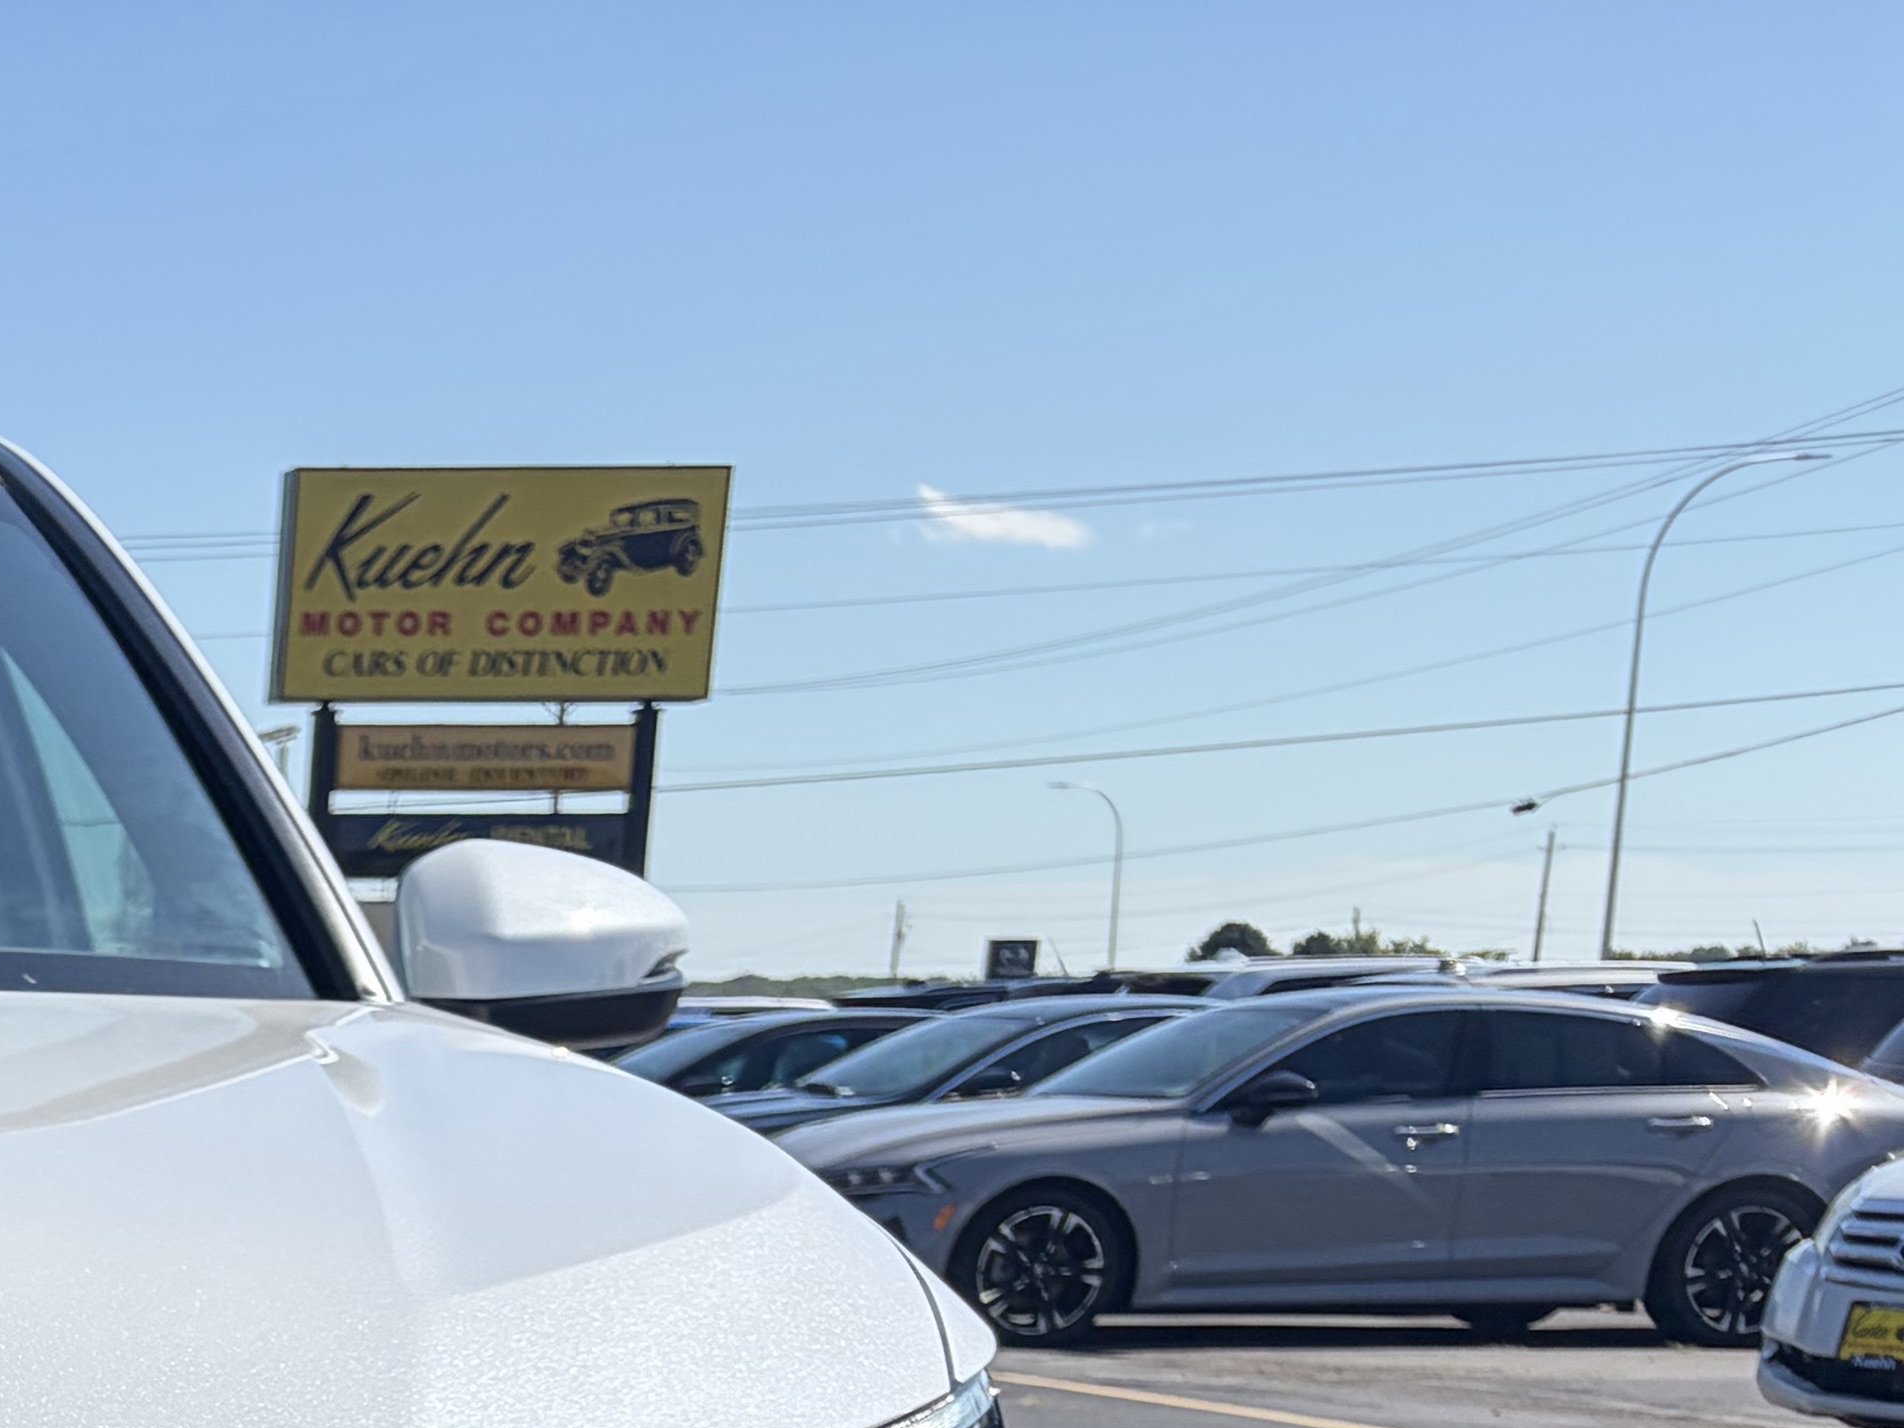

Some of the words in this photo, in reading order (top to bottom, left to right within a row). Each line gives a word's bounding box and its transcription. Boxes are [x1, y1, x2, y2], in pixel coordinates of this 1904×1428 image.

[303, 492, 537, 603] Kuehn
[299, 610, 453, 637] MOTOR
[485, 610, 702, 637] COMPANY
[322, 649, 407, 677] CARS
[415, 649, 464, 677] OF
[467, 649, 669, 677] DISTINCTION
